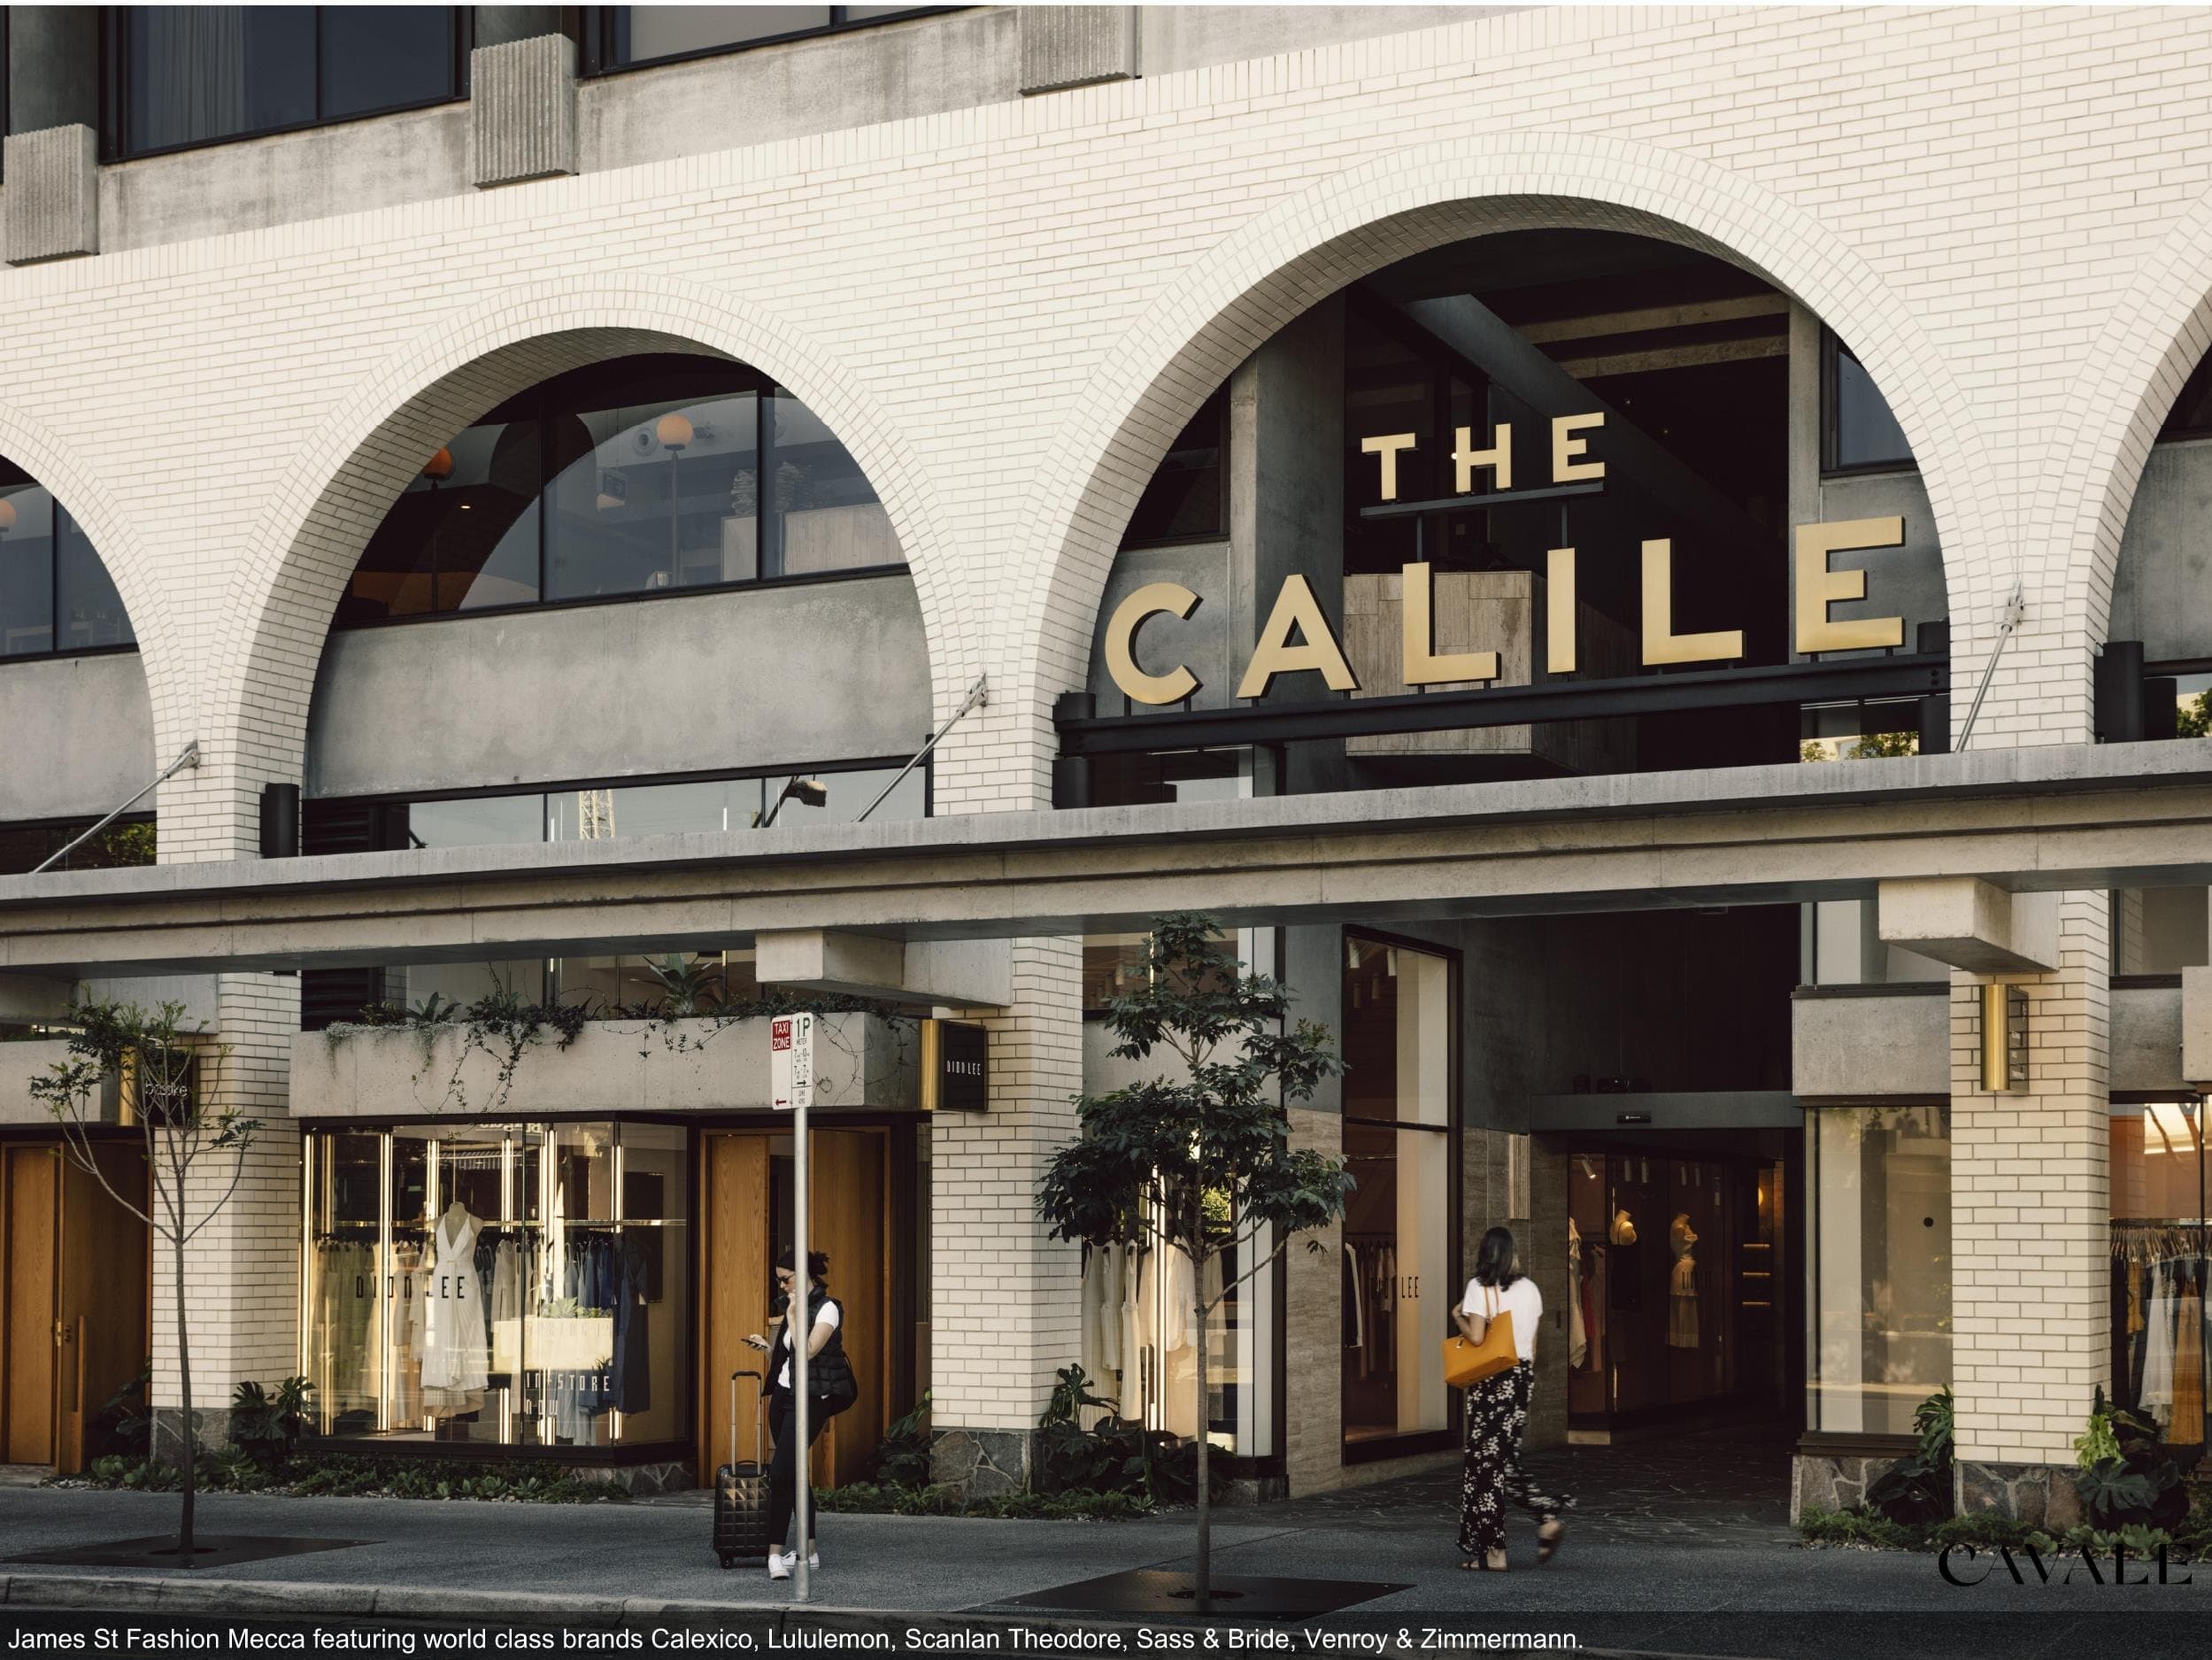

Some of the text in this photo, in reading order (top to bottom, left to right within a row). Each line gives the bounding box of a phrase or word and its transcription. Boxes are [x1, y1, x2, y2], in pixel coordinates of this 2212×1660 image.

[1360, 412, 1606, 501] THE
[1105, 516, 1907, 705] CALILE
[775, 1022, 790, 1034] TAXI
[773, 1037, 790, 1050] ZONE
[967, 1062, 981, 1076] LEE
[426, 1276, 465, 1299] LEE
[1401, 1277, 1419, 1299] LEE
